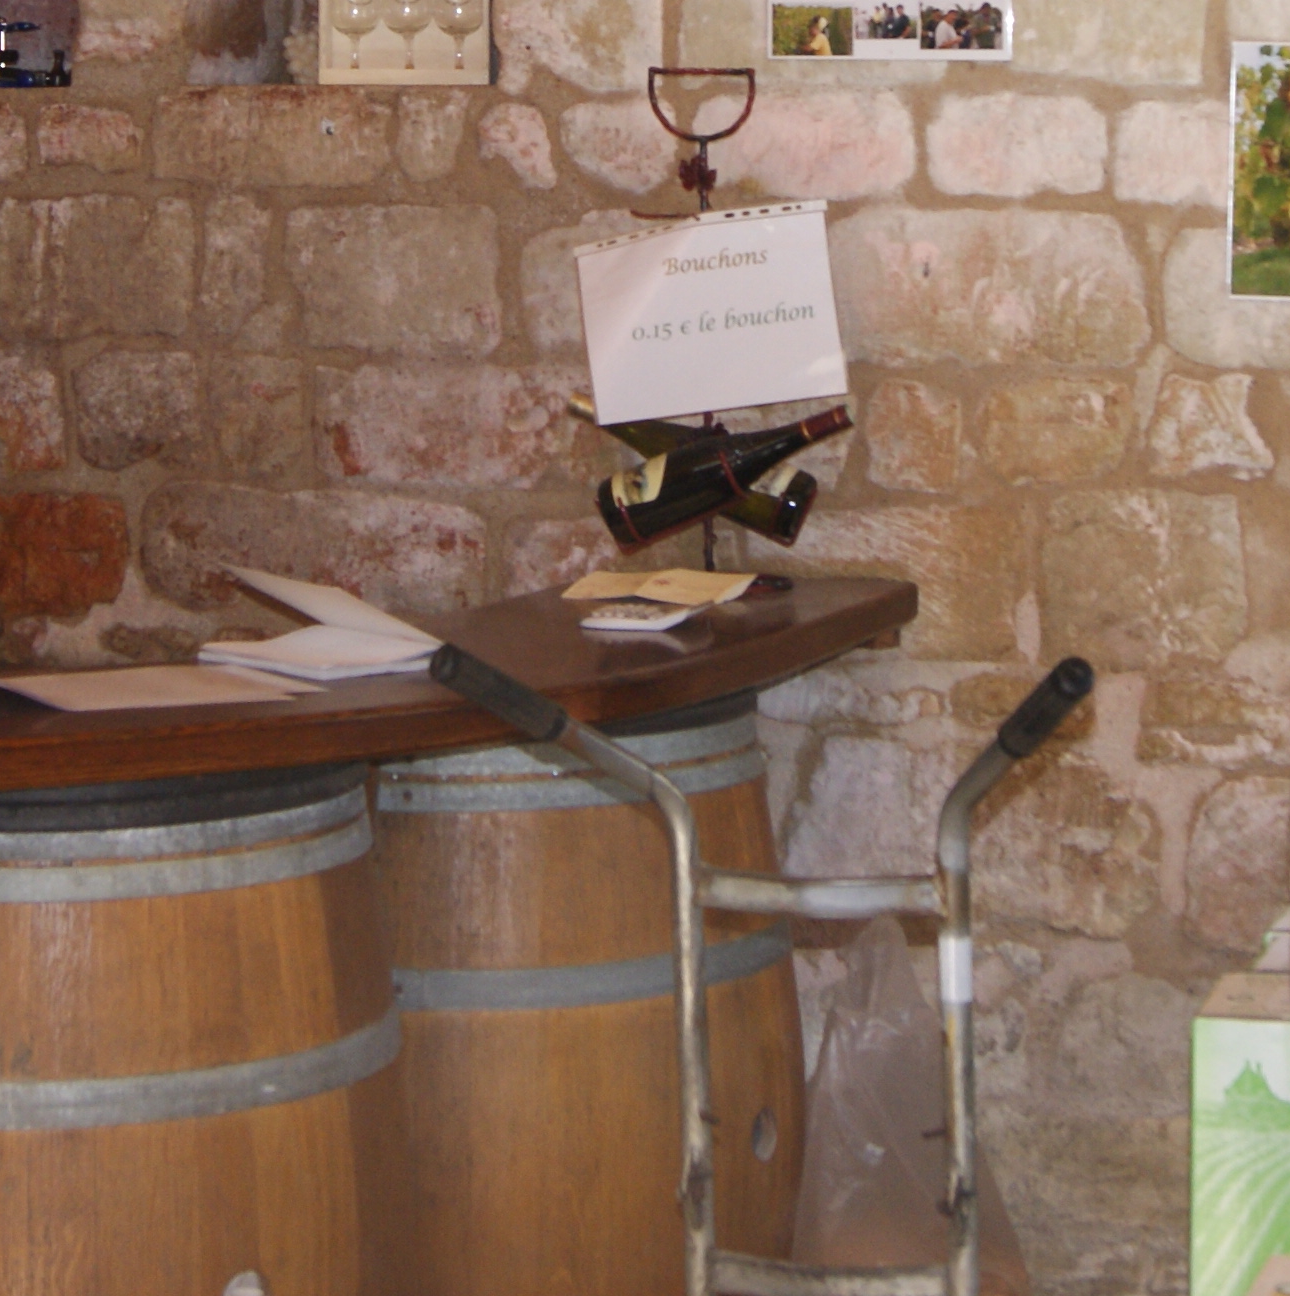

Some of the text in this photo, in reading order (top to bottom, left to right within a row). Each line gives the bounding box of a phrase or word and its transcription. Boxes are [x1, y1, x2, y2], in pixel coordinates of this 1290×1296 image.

[663, 247, 769, 276] Bouchons
[632, 302, 815, 342] 0.15 € le bouchon
